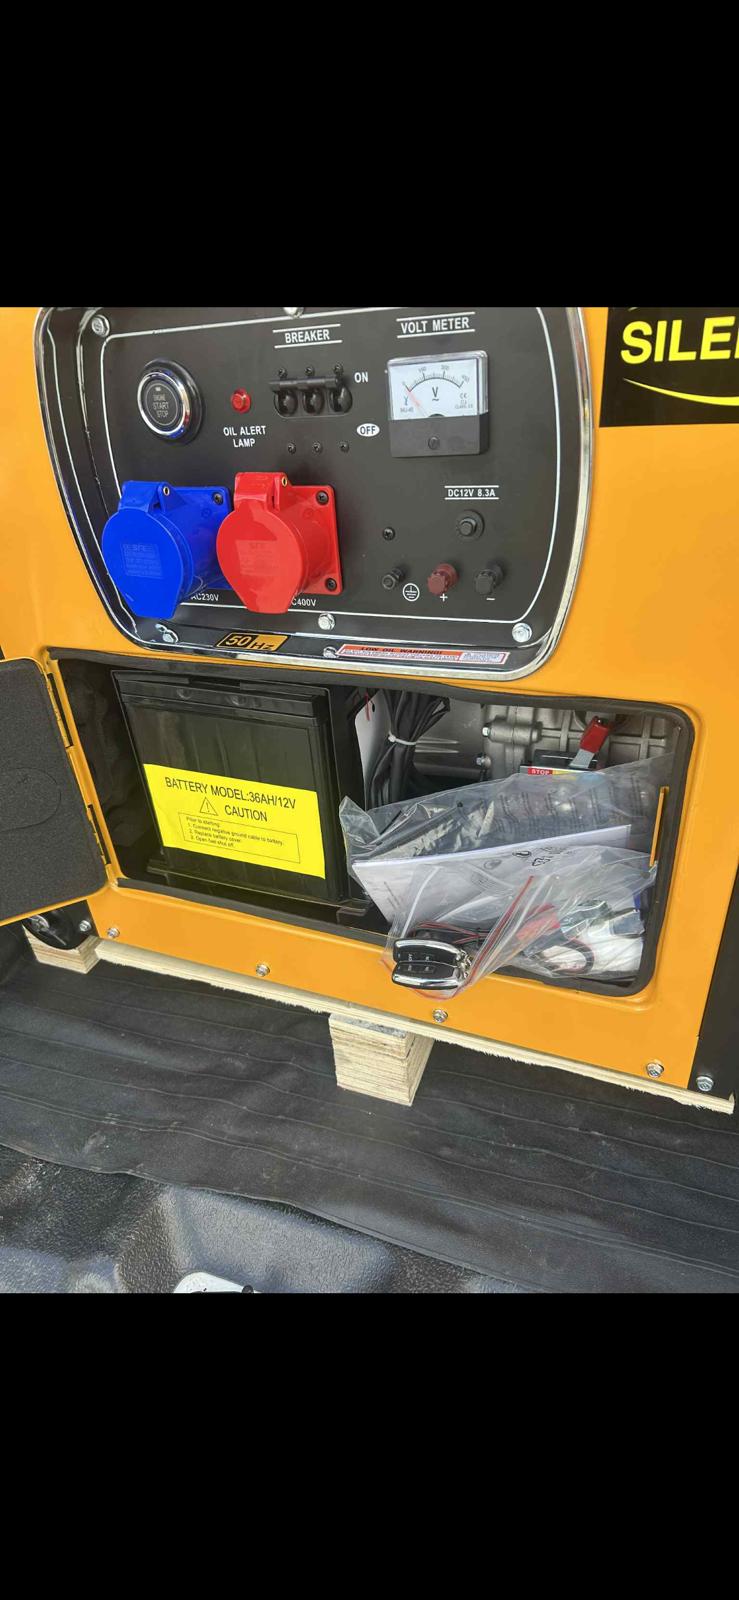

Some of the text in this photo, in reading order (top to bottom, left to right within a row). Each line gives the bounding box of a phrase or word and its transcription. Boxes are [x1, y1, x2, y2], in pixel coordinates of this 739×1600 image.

[401, 317, 470, 334] VOLT METER
[285, 329, 330, 344] BREAKER
[620, 316, 739, 364] SILE
[354, 372, 369, 383] ON
[432, 386, 439, 398] V
[153, 401, 169, 410] START
[156, 410, 169, 418] STOP
[223, 425, 266, 436] OIL ALERT
[359, 425, 377, 435] OFF
[233, 438, 256, 448] LAMP
[447, 488, 496, 497] DC12V 8.3A
[291, 598, 316, 606] C400V
[225, 635, 252, 646] 50
[165, 776, 296, 809] BATTERY MODEL:36AH/12V
[224, 804, 268, 822] CAUTION
[193, 823, 211, 831] Connect
[212, 828, 230, 836] negative
[231, 831, 247, 839] ground
[194, 829, 212, 838] Replace
[213, 833, 228, 841] battery
